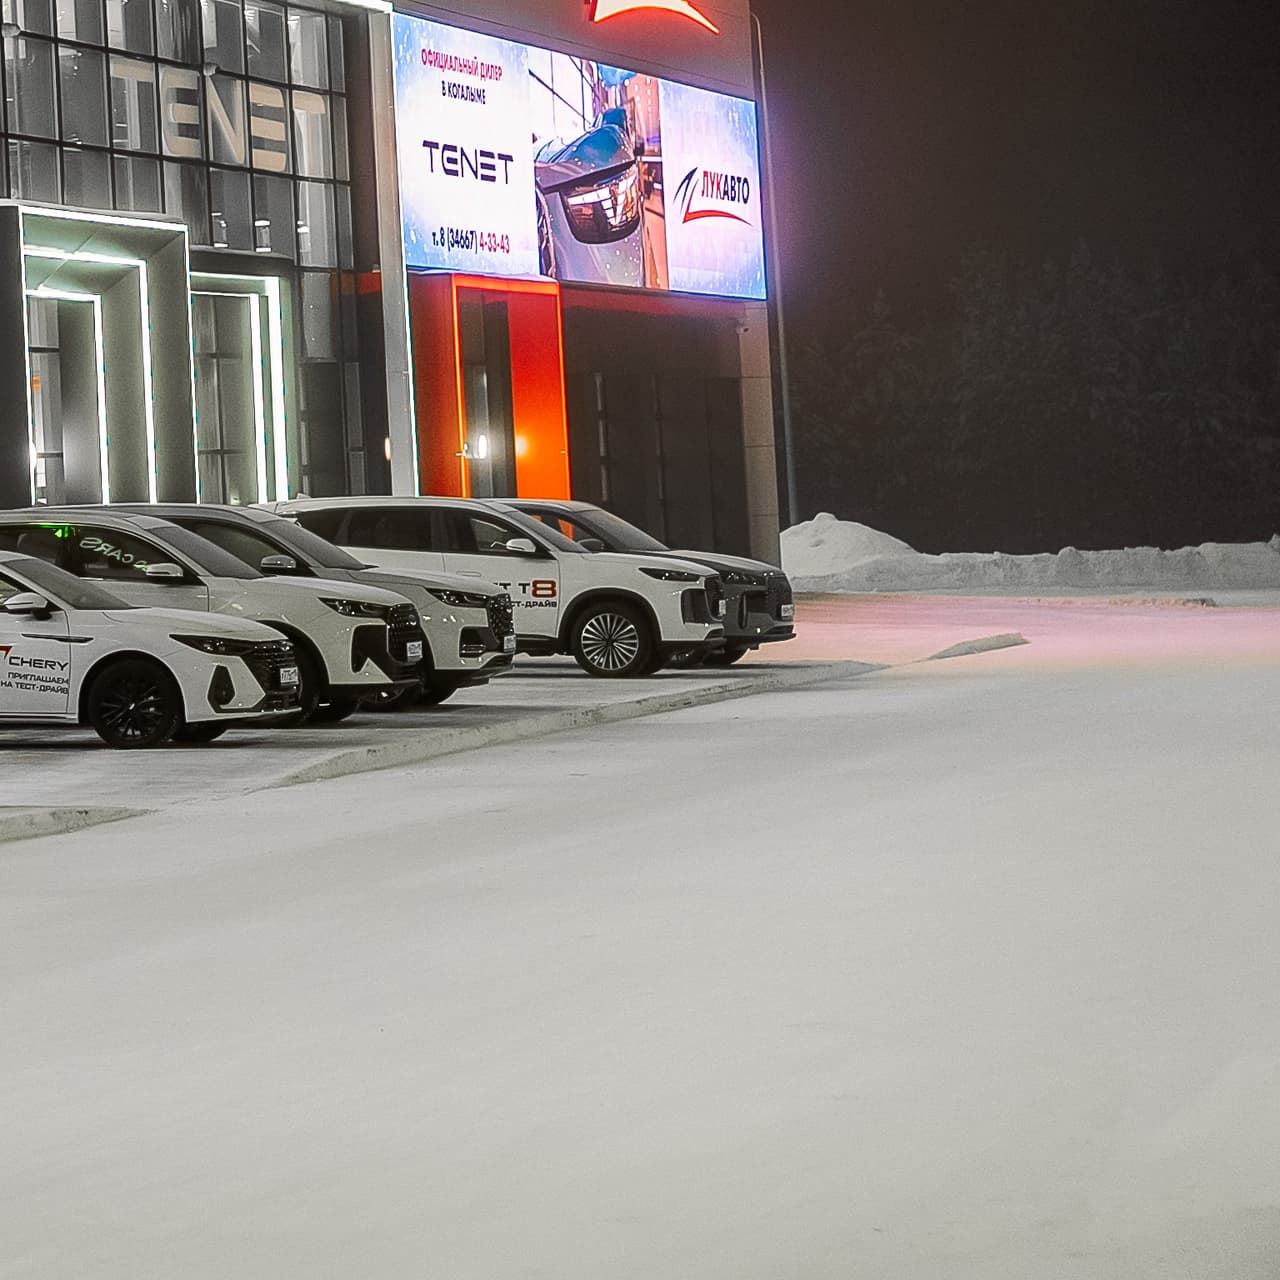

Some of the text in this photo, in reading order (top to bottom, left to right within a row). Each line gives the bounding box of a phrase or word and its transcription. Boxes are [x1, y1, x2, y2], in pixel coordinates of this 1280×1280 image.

[421, 48, 503, 81] ОФИЦИАЛЬНЫЙ ДИЛЕР
[448, 82, 486, 105] КОГАЛЫМЕ
[110, 55, 327, 176] TENET
[422, 140, 514, 185] TENET
[701, 170, 750, 205] ЛУКАВТО
[480, 231, 510, 254] 4-33-43
[8, 656, 69, 671] CHERY
[0, 680, 69, 695] НА ТЕСТ-ДРАЙВ
[7, 672, 69, 684] ПРИГЛАШАЕМ
